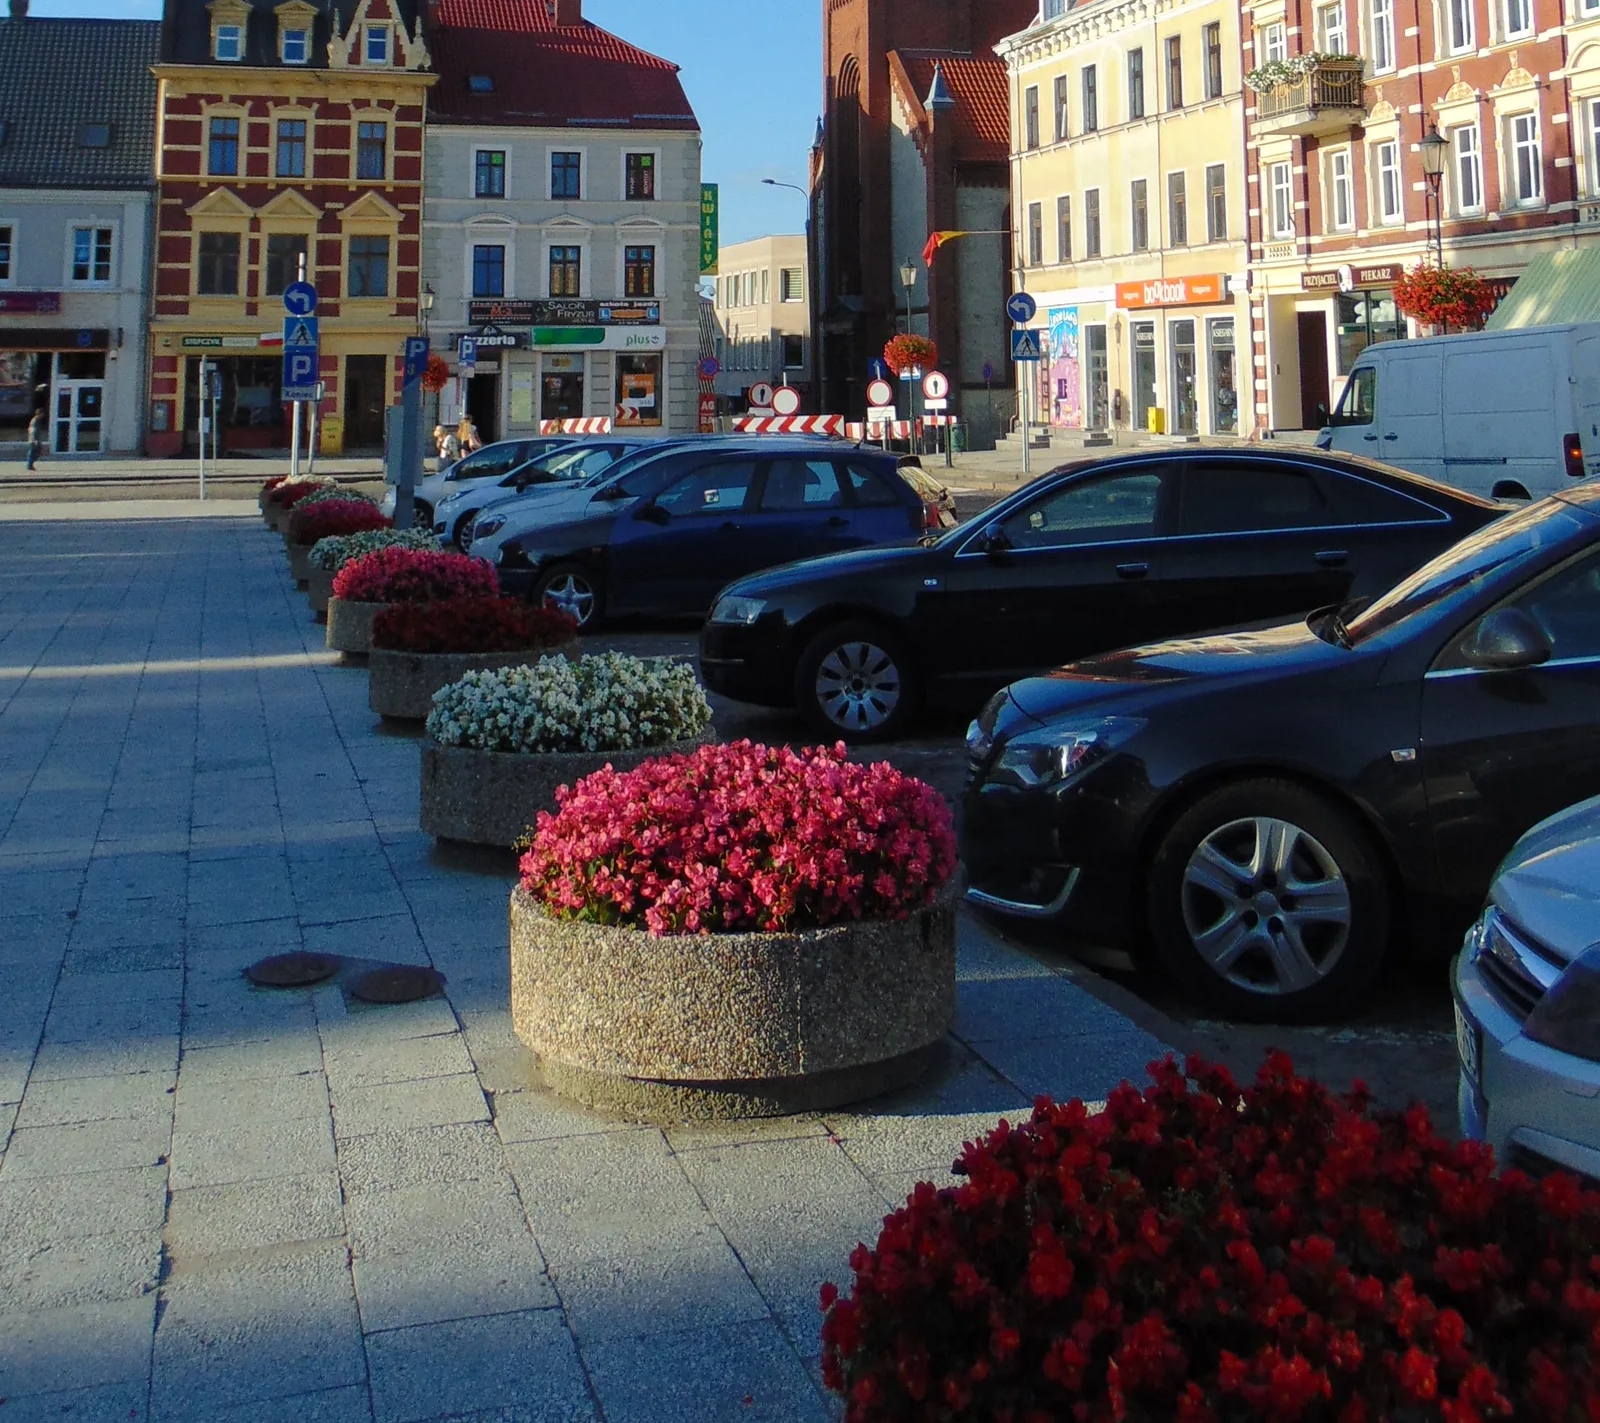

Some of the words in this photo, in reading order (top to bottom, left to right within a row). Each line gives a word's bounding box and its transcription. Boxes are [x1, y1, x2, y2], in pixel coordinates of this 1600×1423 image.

[701, 190, 715, 265] KWIATY
[1303, 273, 1338, 287] PRZYJACIEL
[1360, 268, 1392, 281] PIEKARZ
[1144, 279, 1186, 305] bookbook
[548, 301, 585, 310] SALON
[557, 309, 595, 318] FRYZUR
[476, 335, 516, 346] zzeria
[626, 333, 650, 346] plus
[411, 340, 427, 358] P
[461, 340, 473, 359] P
[291, 355, 312, 382] P
[285, 390, 314, 399] Koniec
